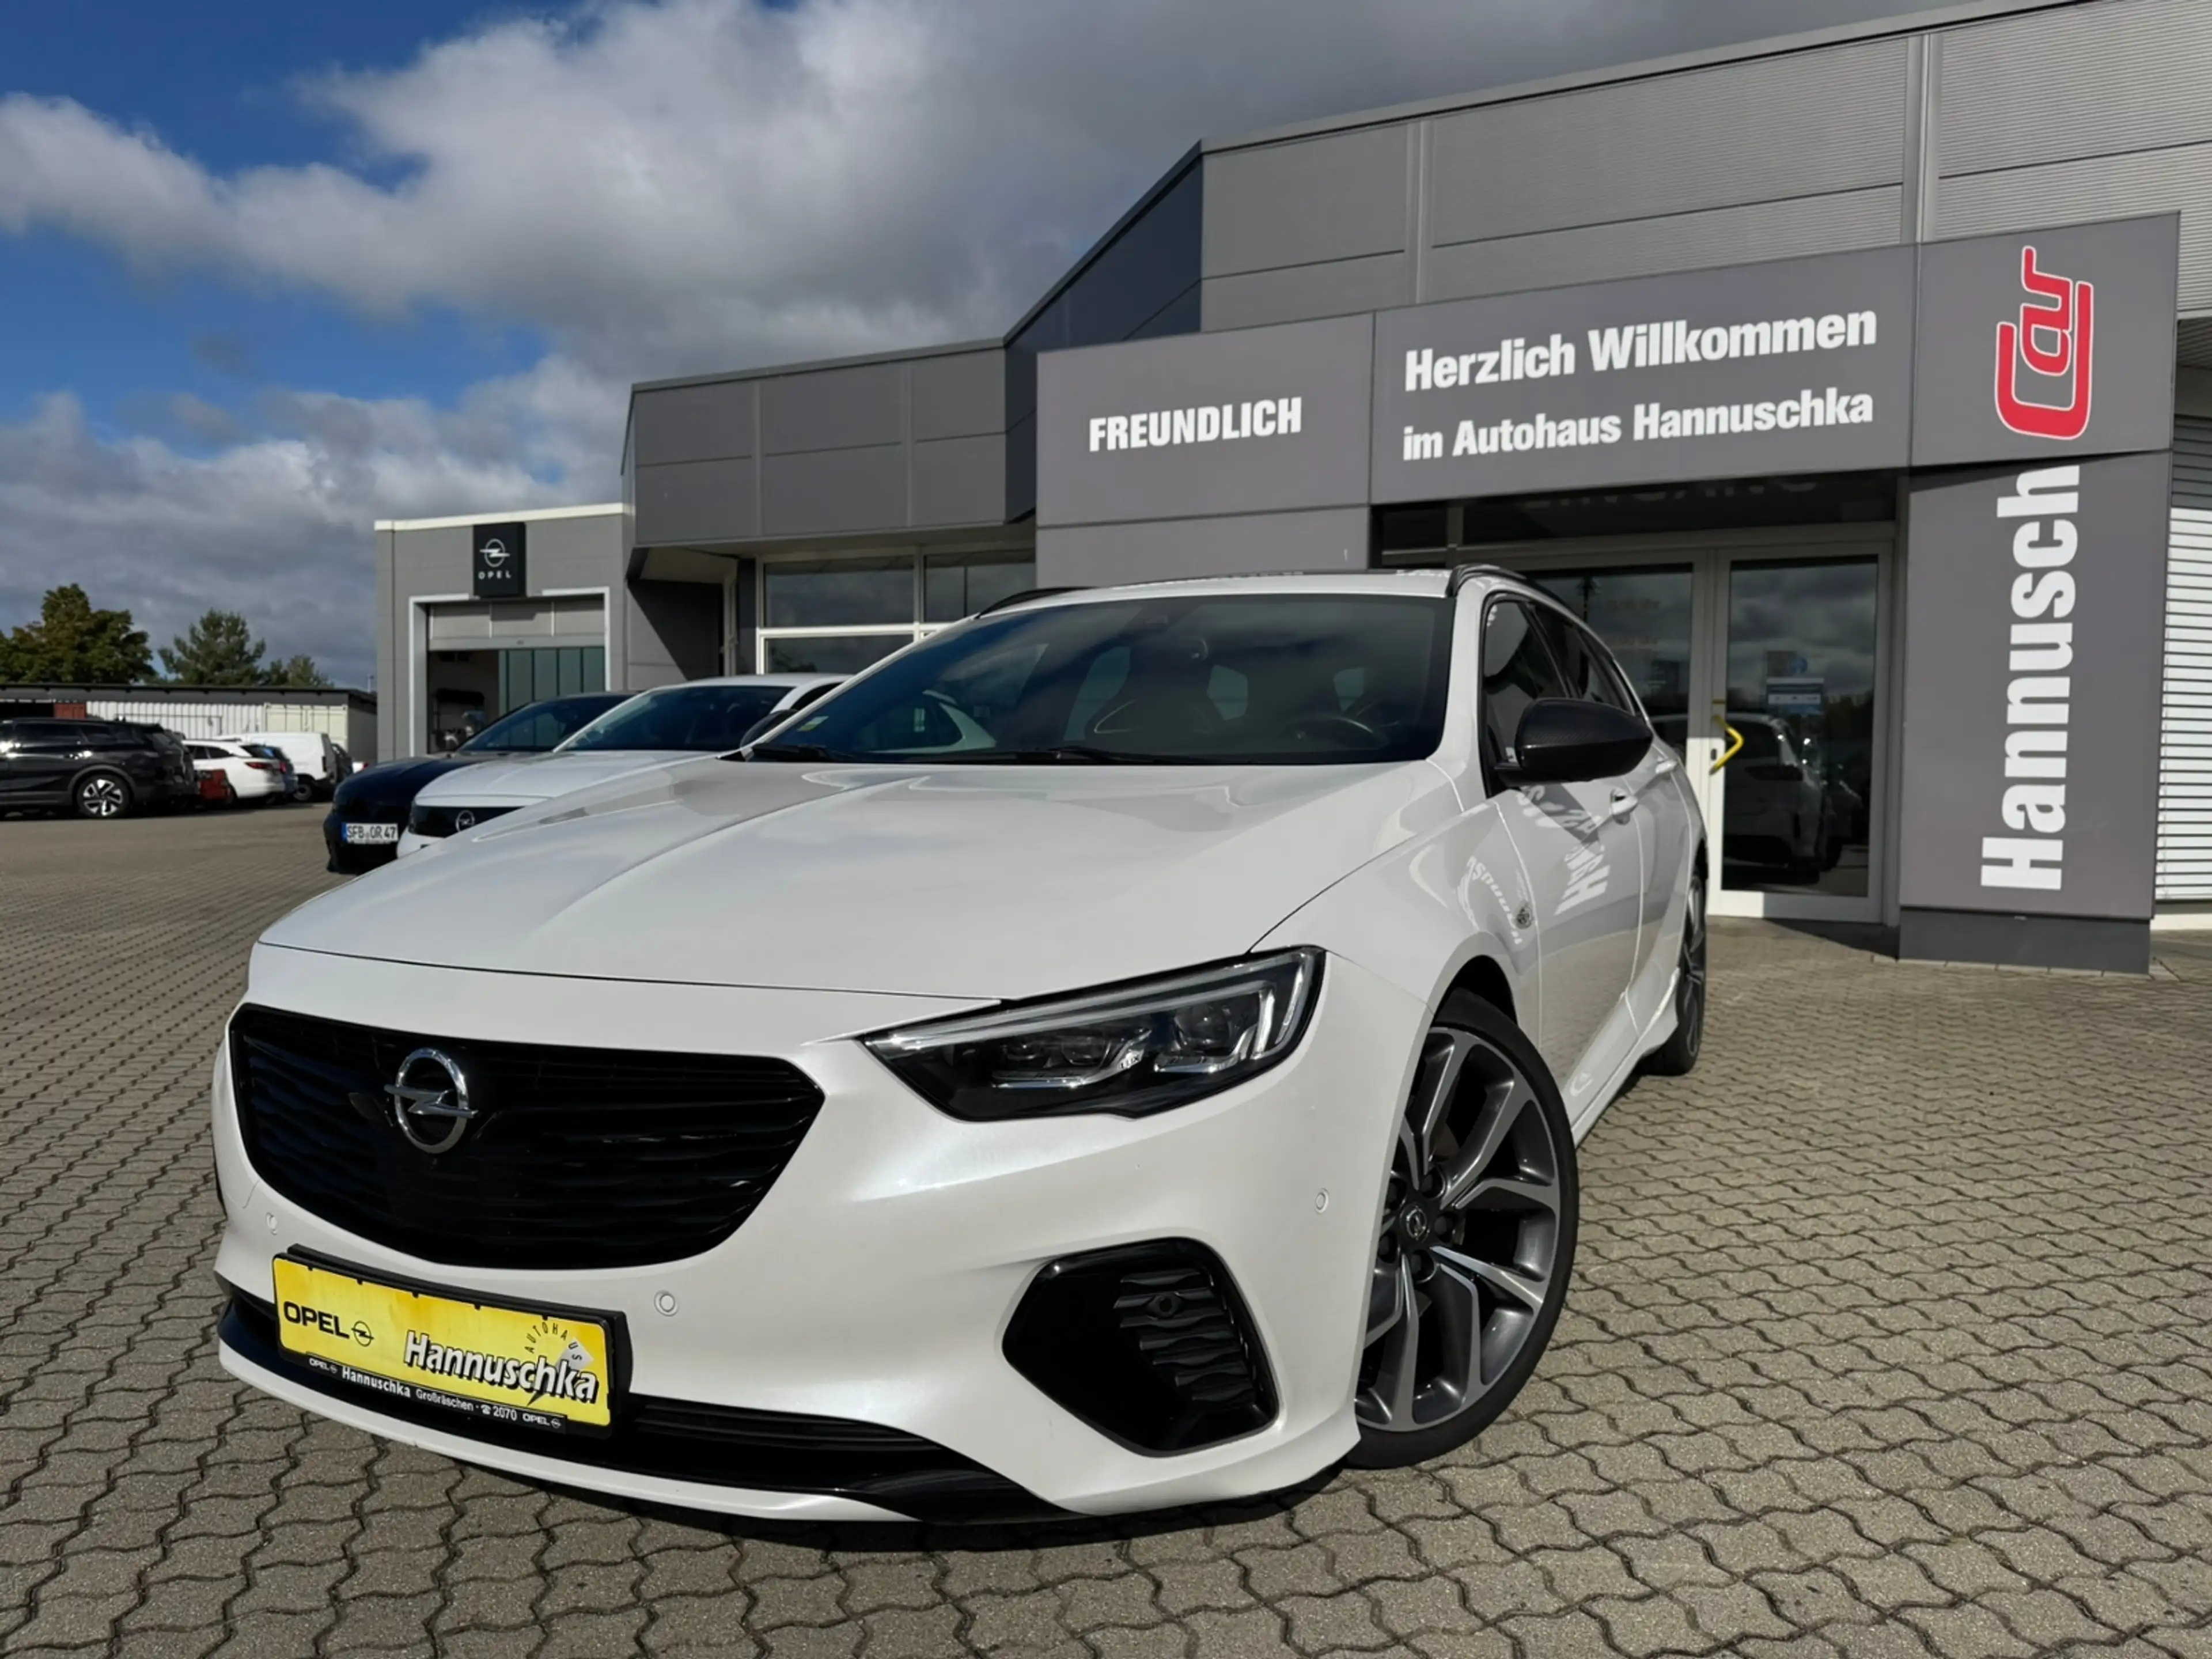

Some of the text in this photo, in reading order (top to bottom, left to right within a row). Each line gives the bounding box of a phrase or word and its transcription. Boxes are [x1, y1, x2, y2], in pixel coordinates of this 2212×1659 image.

[1404, 310, 1877, 392] Herzlich Willkommen
[1089, 396, 1302, 452] FREUNDLICH
[1403, 387, 1874, 461] im Autohaus Hannuschka
[478, 570, 512, 580] OPEL
[1980, 464, 2080, 891] Hannusch
[283, 1301, 350, 1339] OPEL
[524, 1321, 583, 1361] AUTOHAUS
[309, 1357, 550, 1426] OPEL Hannuschka Großräschen 2070 OPEL
[404, 1330, 599, 1404] Hannuschka
